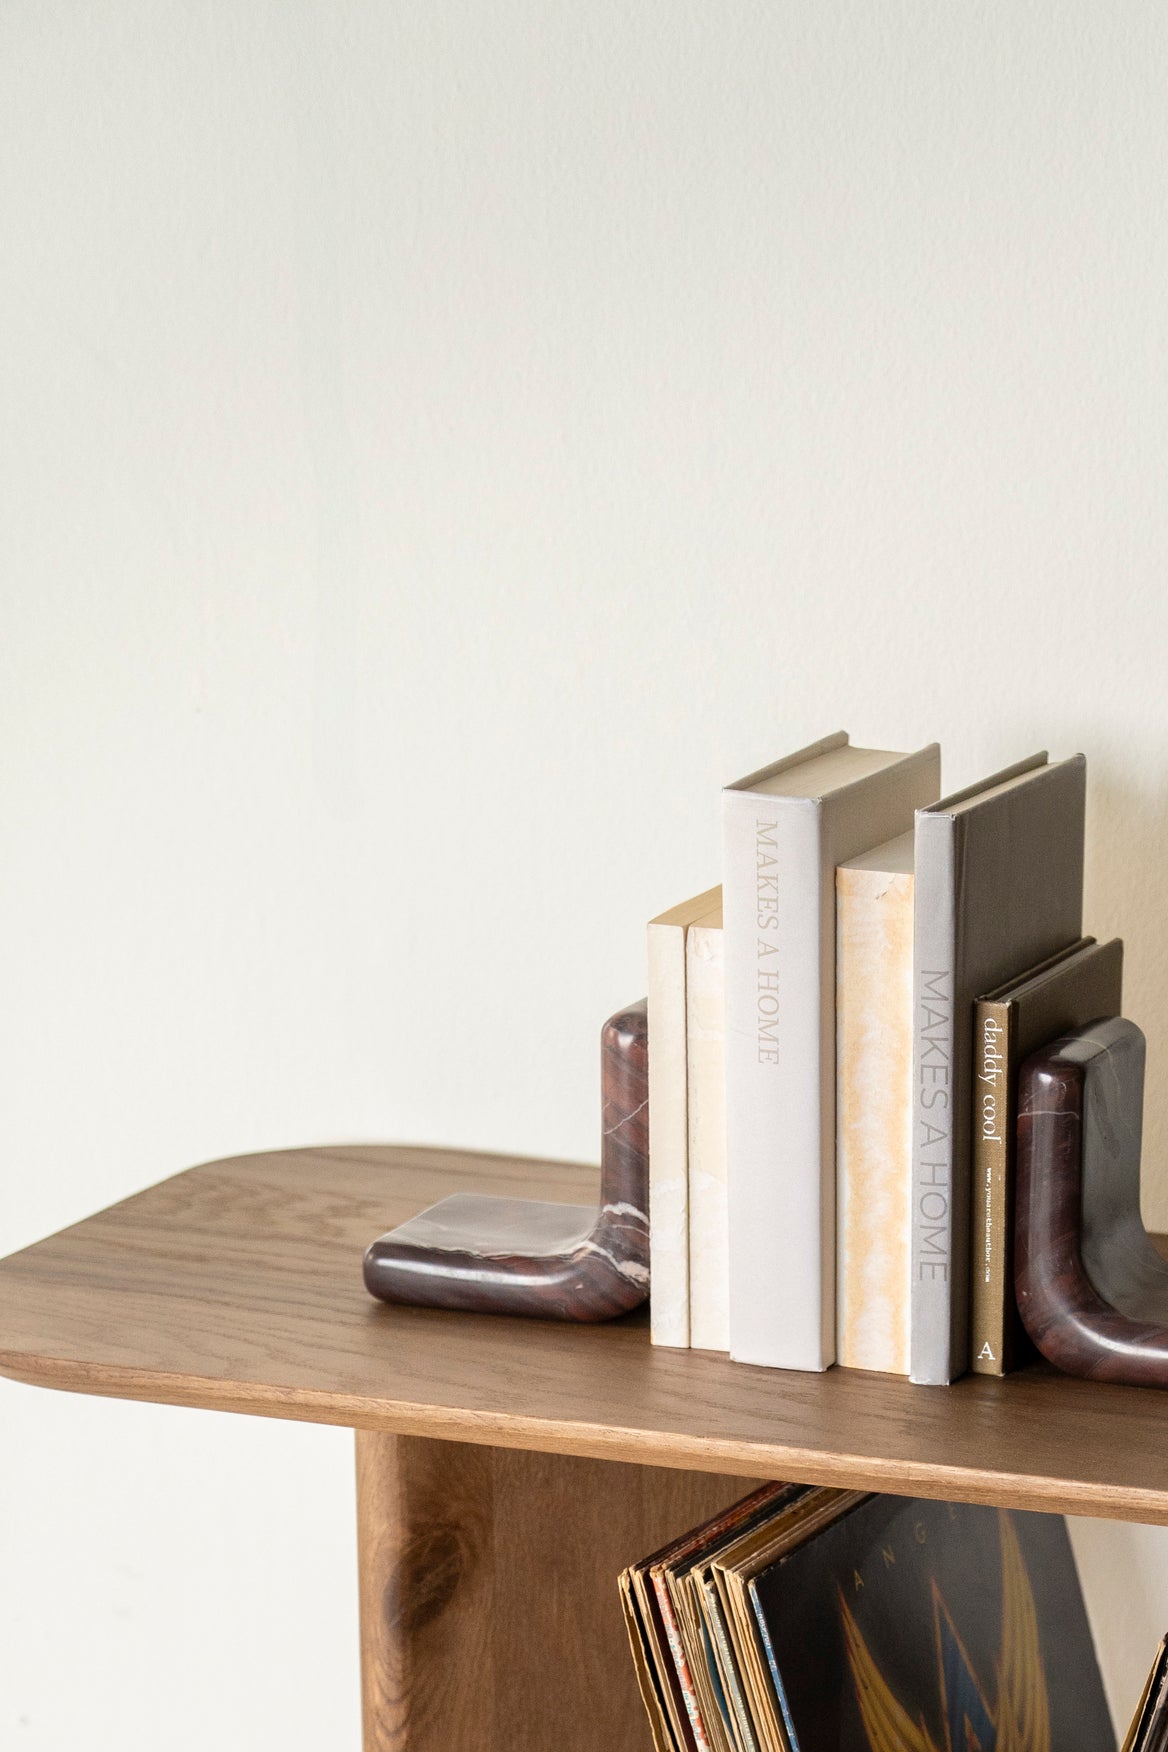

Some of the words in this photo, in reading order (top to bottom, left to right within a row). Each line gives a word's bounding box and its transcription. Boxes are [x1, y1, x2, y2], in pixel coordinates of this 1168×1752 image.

[756, 819, 780, 931] MAKES
[757, 938, 779, 961] A
[756, 967, 780, 1065] HOME
[919, 969, 950, 1110] MAKES
[977, 1018, 1004, 1087] daddy
[919, 1122, 949, 1148] A
[982, 1094, 1002, 1142] cool
[918, 1160, 948, 1283] HOME
[977, 1340, 995, 1361] A
